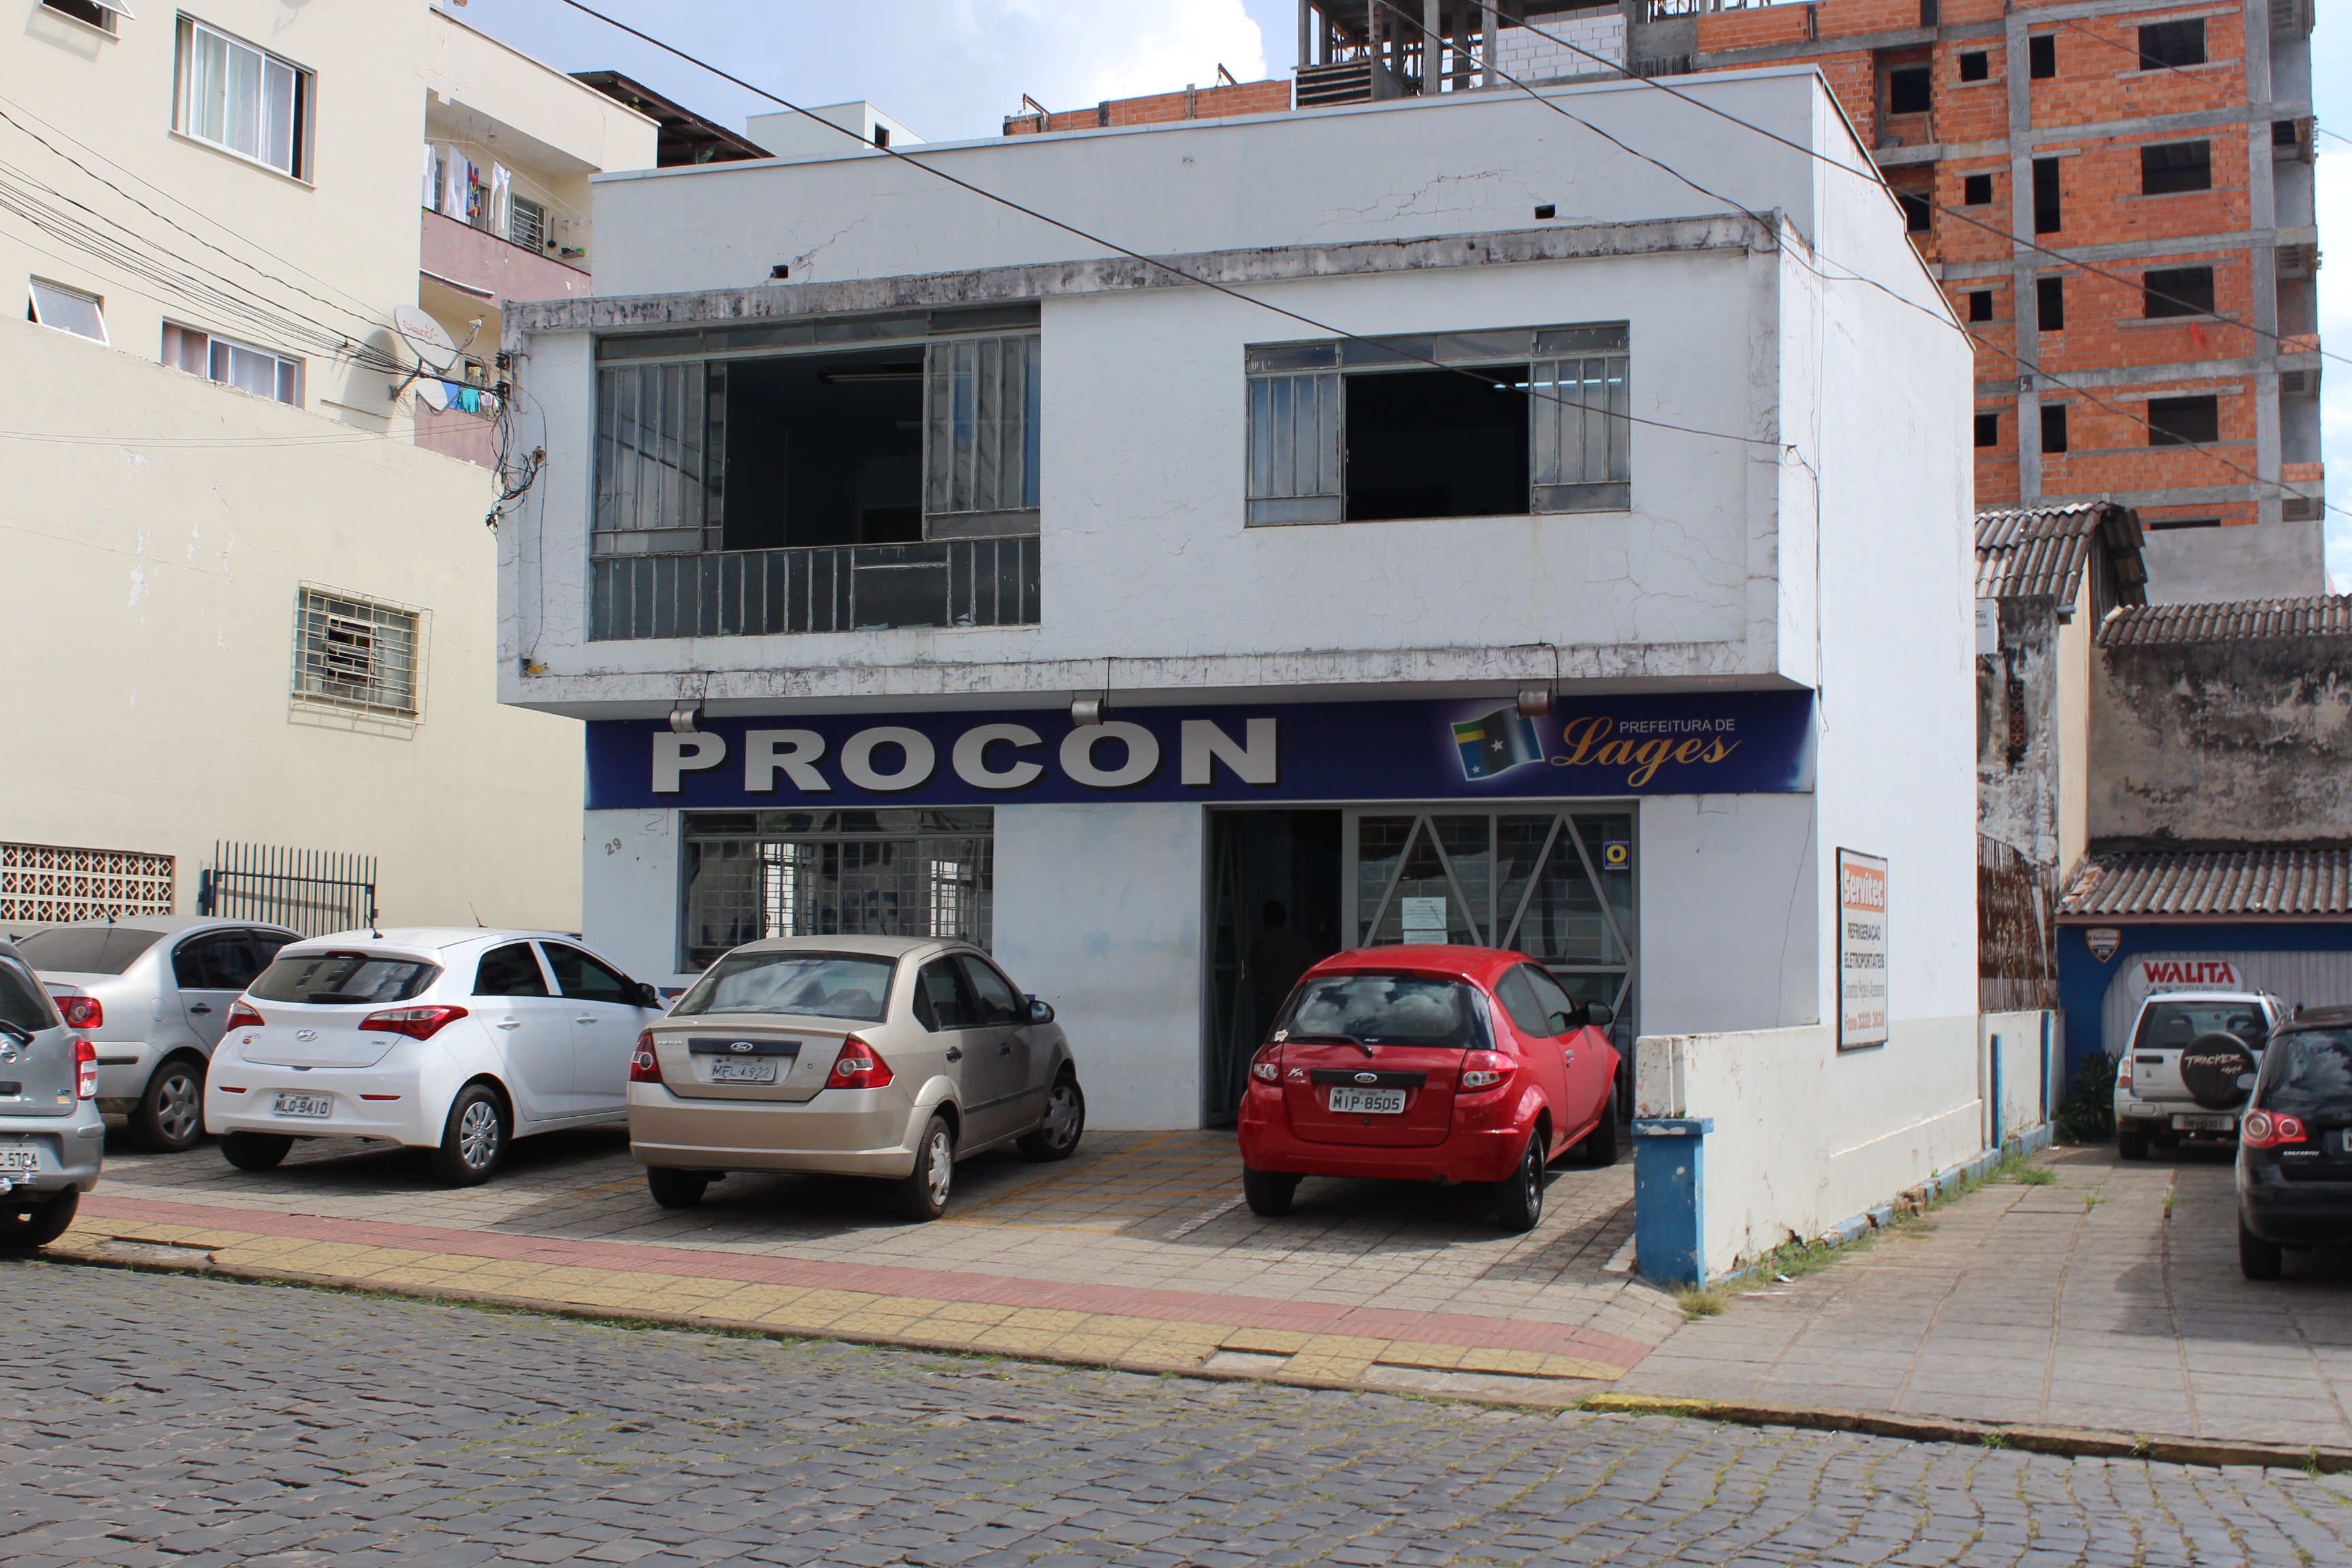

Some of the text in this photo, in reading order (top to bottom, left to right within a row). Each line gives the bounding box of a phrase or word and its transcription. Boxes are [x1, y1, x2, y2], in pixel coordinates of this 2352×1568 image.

[403, 320, 433, 339] Claro
[1620, 719, 1735, 734] PREFEITURA DE
[651, 717, 1277, 793] PROCON
[1550, 717, 1742, 787] Lages
[604, 838, 622, 856] 29
[1844, 869, 1884, 908] Servitec
[1847, 921, 1880, 944] REFRIGERAÇÃO
[1844, 950, 1884, 968] ELETROPORTÁTEIS
[2142, 962, 2235, 983] WALITA
[1858, 1012, 1871, 1029] 3222
[2185, 1054, 2245, 1071] TRACKER
[1333, 1096, 1400, 1110] MIP-8505
